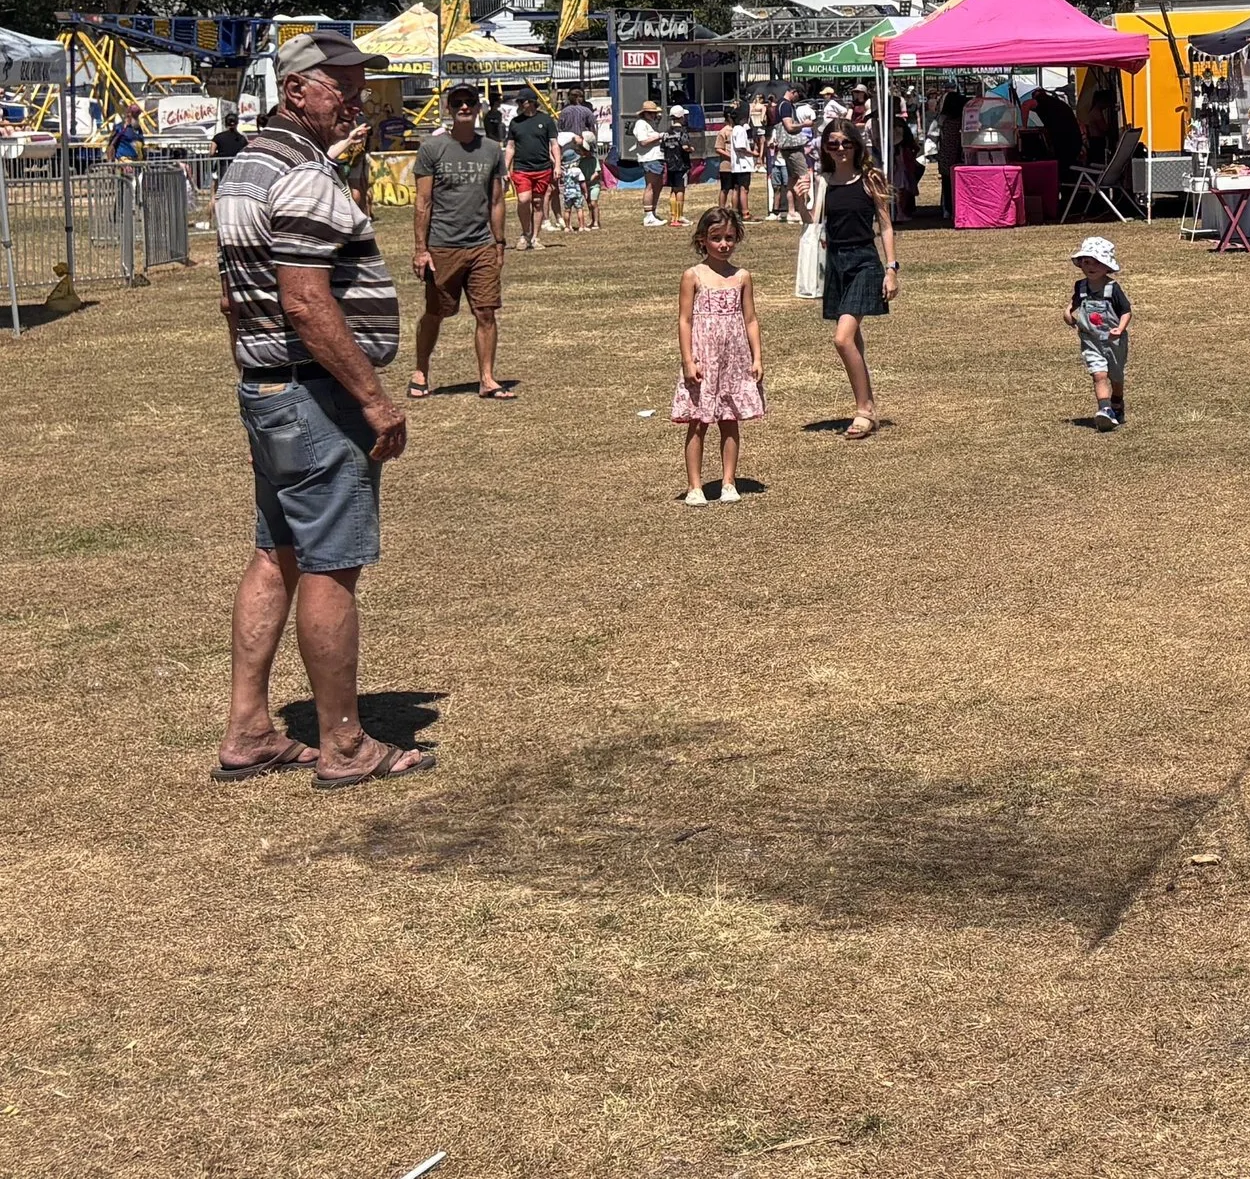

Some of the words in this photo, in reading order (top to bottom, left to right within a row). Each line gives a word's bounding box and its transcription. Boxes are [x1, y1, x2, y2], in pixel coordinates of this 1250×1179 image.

[627, 52, 645, 66] EXIT
[387, 61, 433, 76] NADE
[447, 61, 464, 75] ICE
[465, 61, 493, 75] COLD
[494, 60, 548, 74] LEMONADE
[808, 64, 841, 74] MICHAEL
